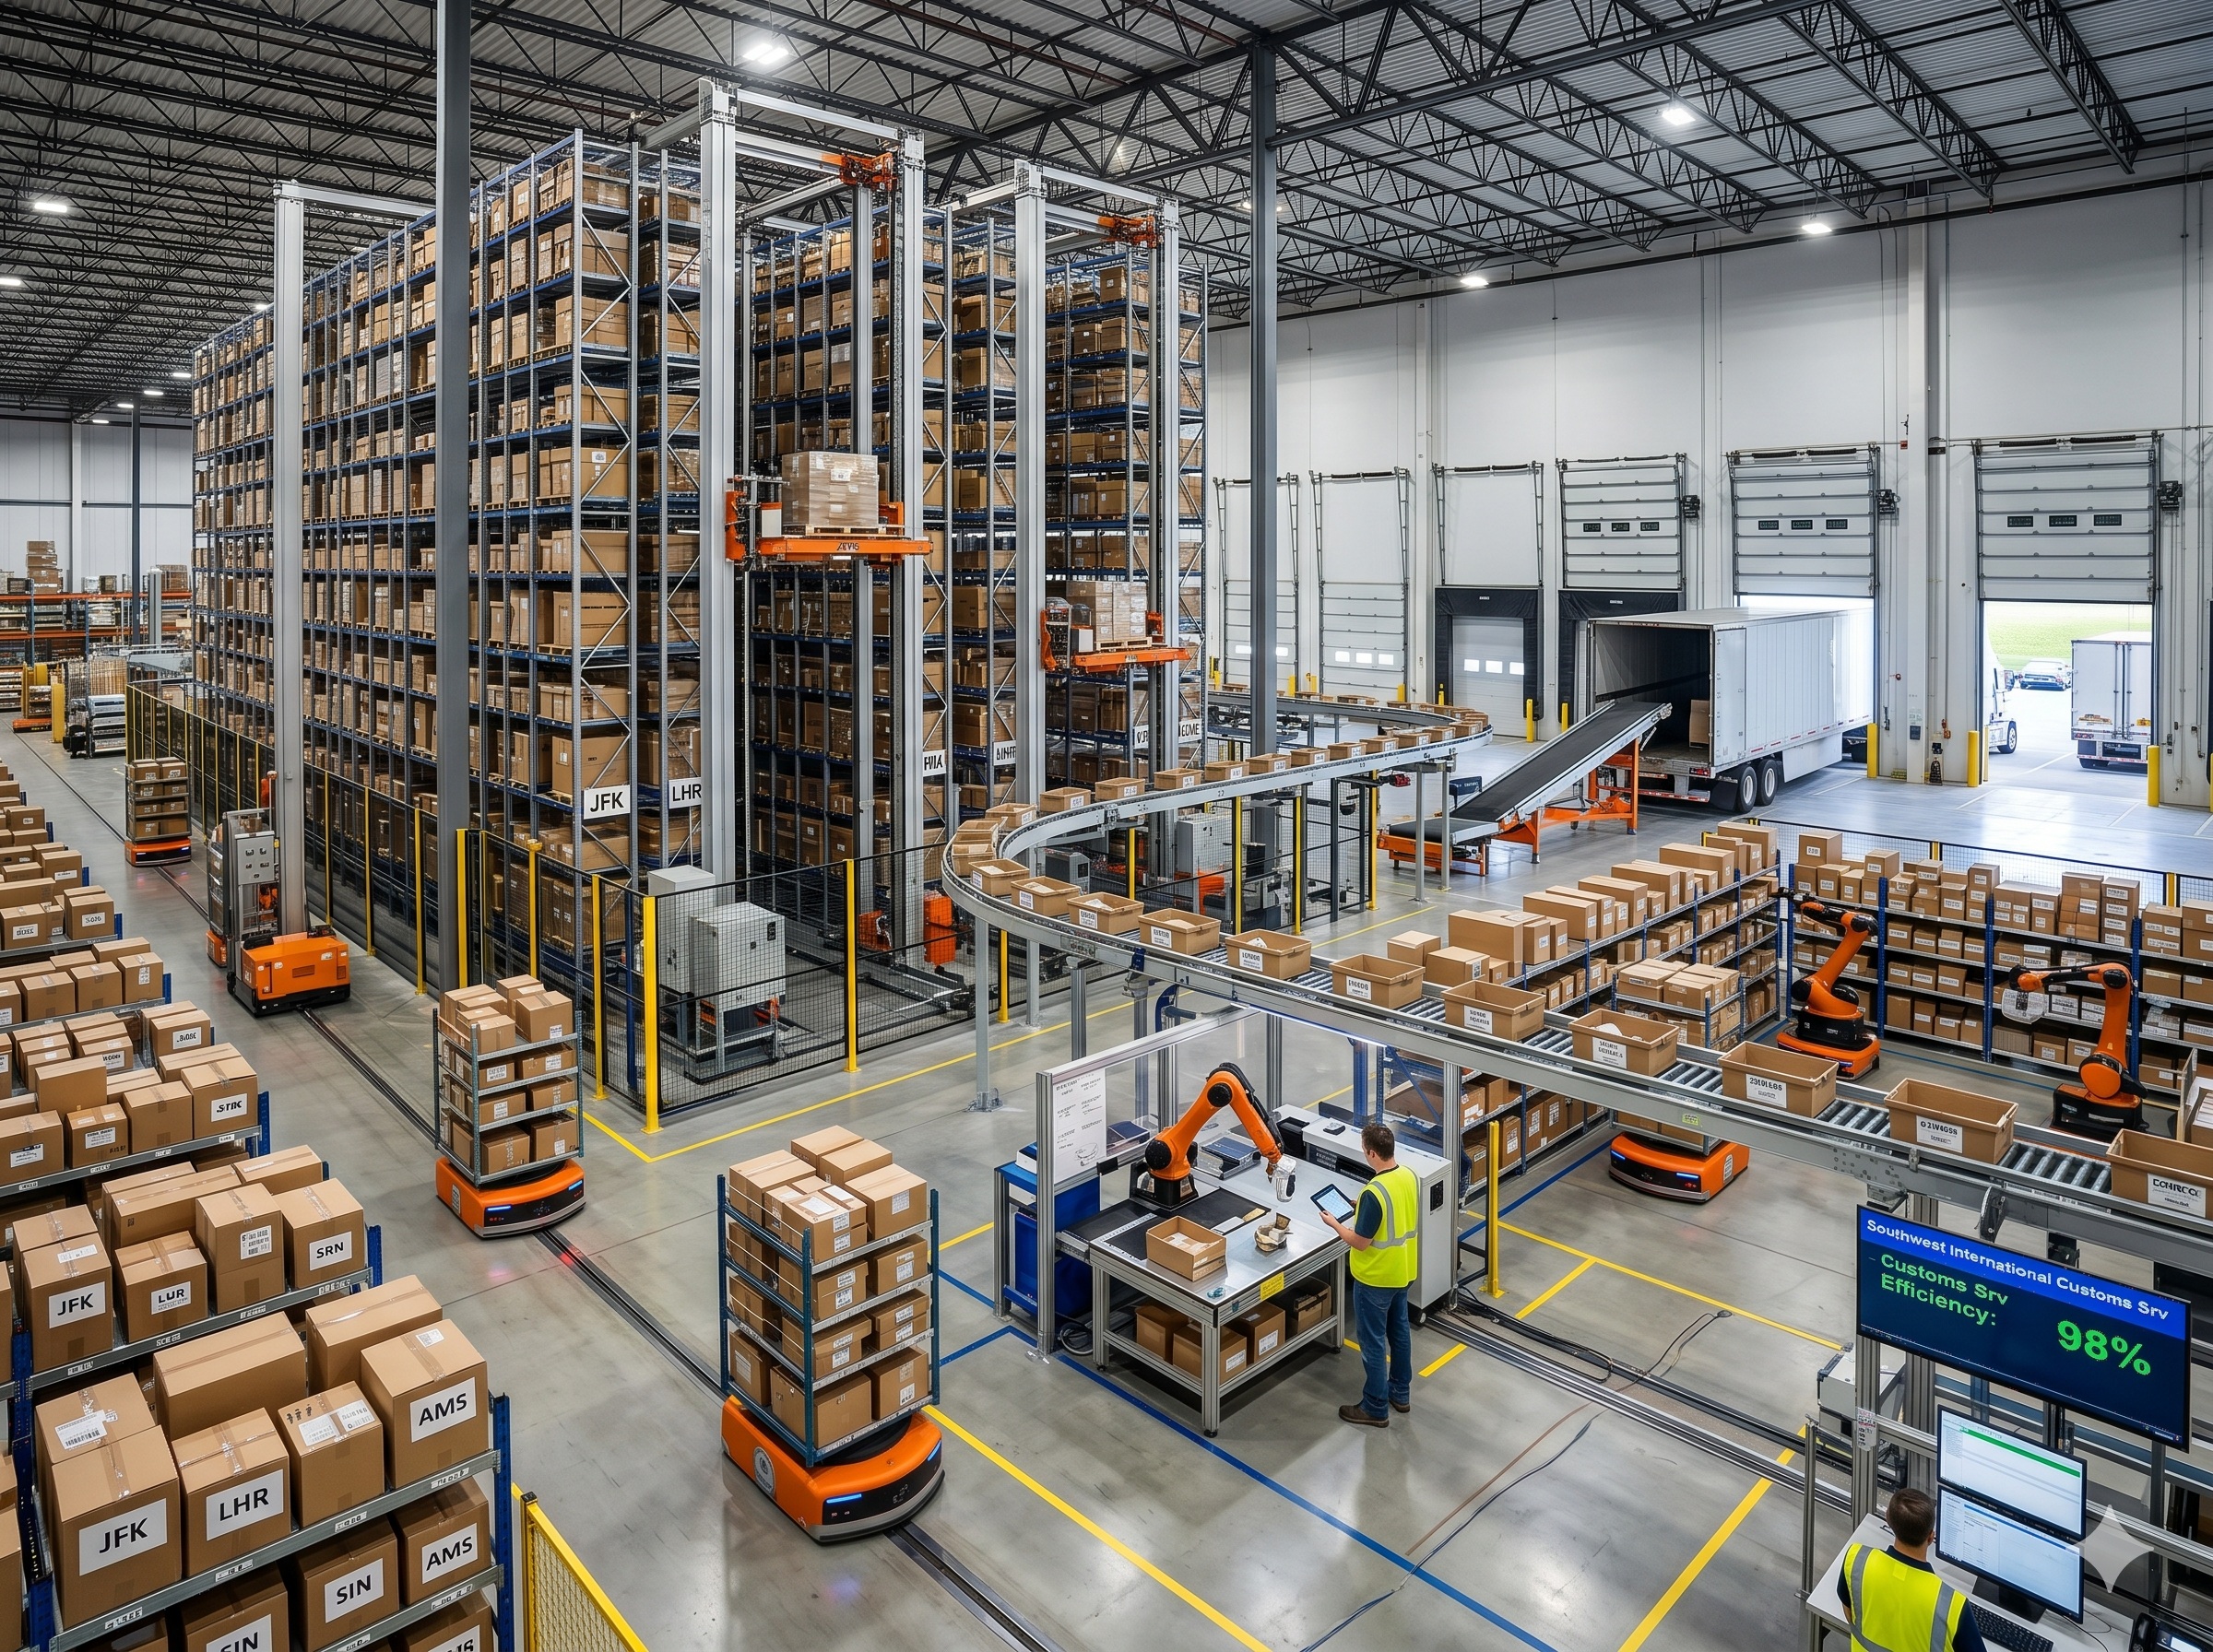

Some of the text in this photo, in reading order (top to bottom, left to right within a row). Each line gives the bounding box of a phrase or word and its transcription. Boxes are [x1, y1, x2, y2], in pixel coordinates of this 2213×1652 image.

[590, 791, 624, 812] JFK
[673, 784, 702, 802] LHR
[316, 1242, 343, 1258] SRN
[1867, 1220, 2169, 1320] Southwest International Customs Srv
[1881, 1254, 2008, 1305] Customs Srv
[57, 1292, 94, 1316] JFK
[158, 1289, 184, 1304] LUR
[1881, 1273, 1996, 1326] Efficiency:
[2057, 1320, 2151, 1375] 98%
[419, 1392, 467, 1426] AMS
[220, 1488, 269, 1521] LHR
[99, 1516, 148, 1553] JFK
[426, 1536, 473, 1571] AMS
[337, 1575, 371, 1605] SIN
